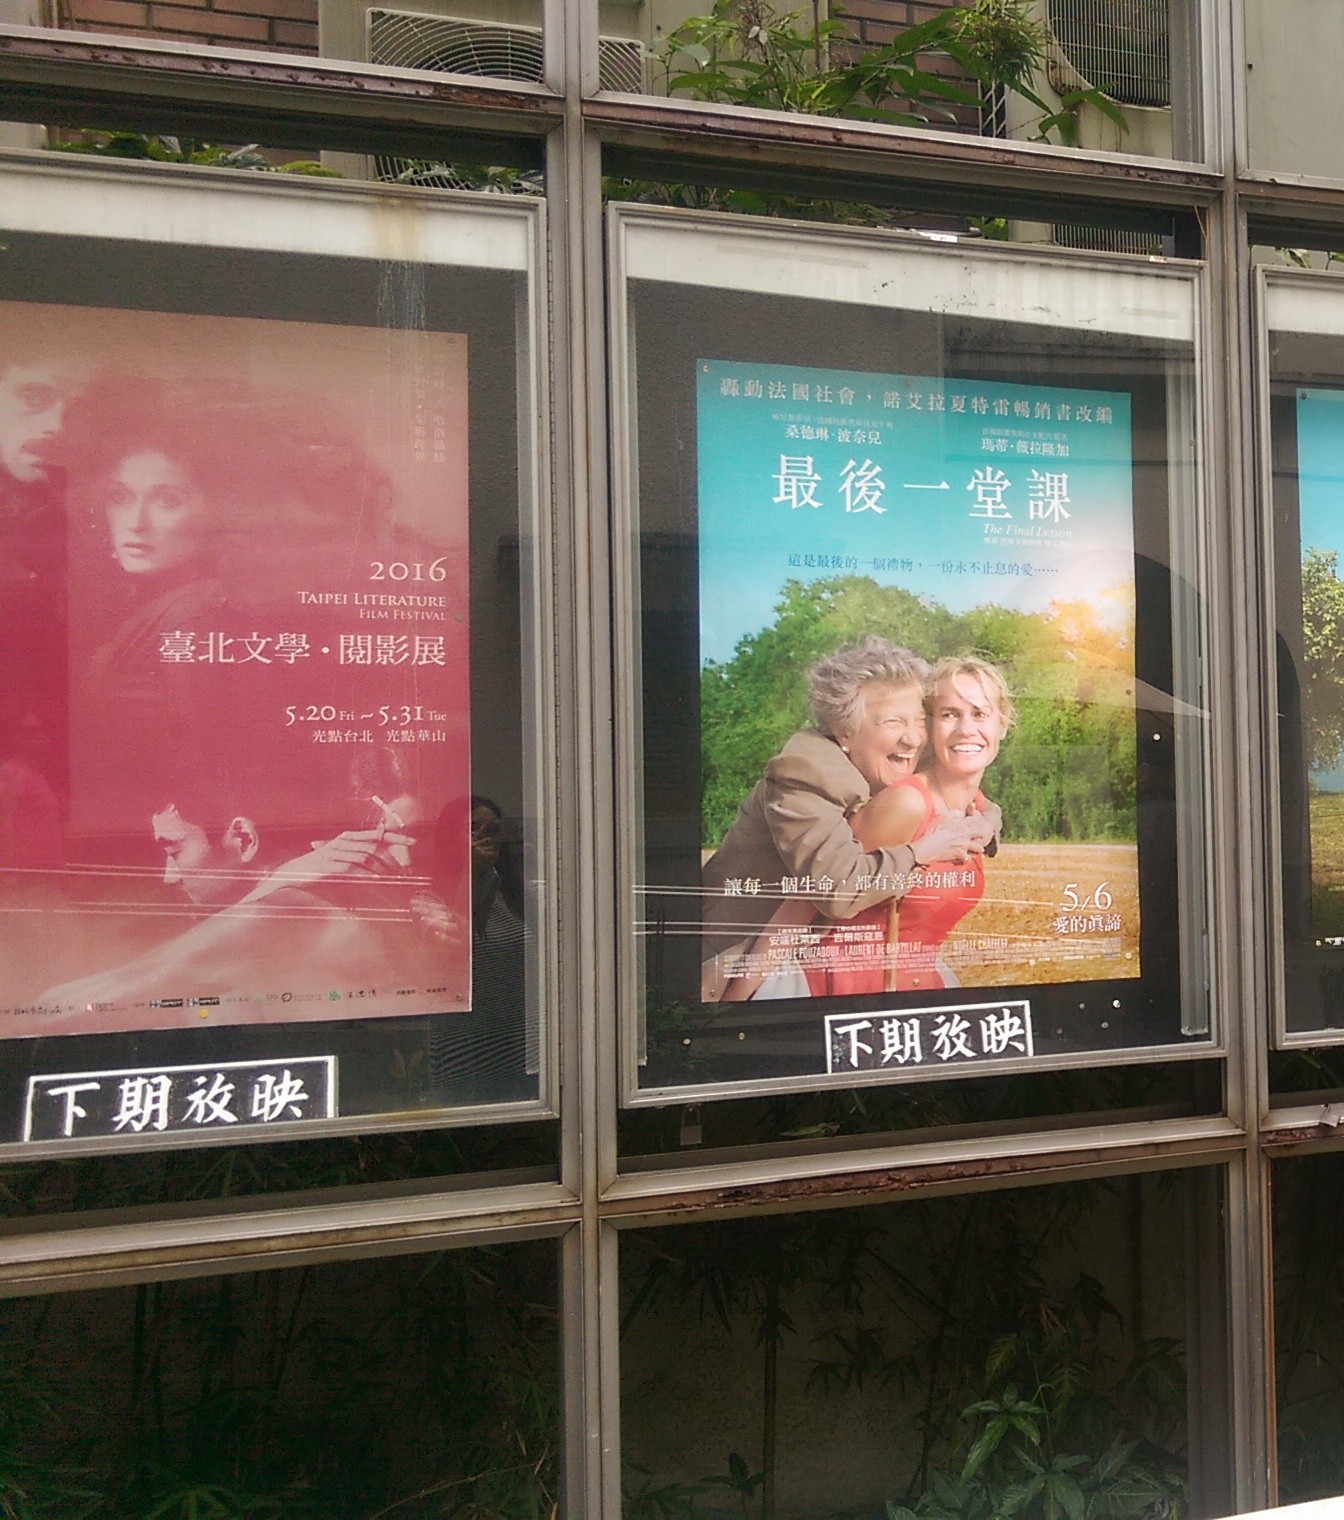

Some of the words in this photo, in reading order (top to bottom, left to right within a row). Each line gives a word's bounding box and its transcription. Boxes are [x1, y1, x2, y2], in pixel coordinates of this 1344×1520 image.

[771, 454, 1073, 524] 最後一堂課
[983, 523, 1003, 535] The
[1006, 524, 1035, 537] Final
[1036, 526, 1073, 539] Lesson
[369, 556, 448, 583] 2016
[285, 704, 337, 727] 5.20
[339, 711, 355, 721] Fri
[378, 704, 425, 726] 5.31
[427, 710, 447, 721] Tue
[312, 729, 374, 743] 光點台北
[386, 729, 446, 743] 光點華山
[1062, 881, 1112, 912] 5/6
[833, 1007, 1027, 1068] 下期放映
[46, 1067, 311, 1138] 下期放映
